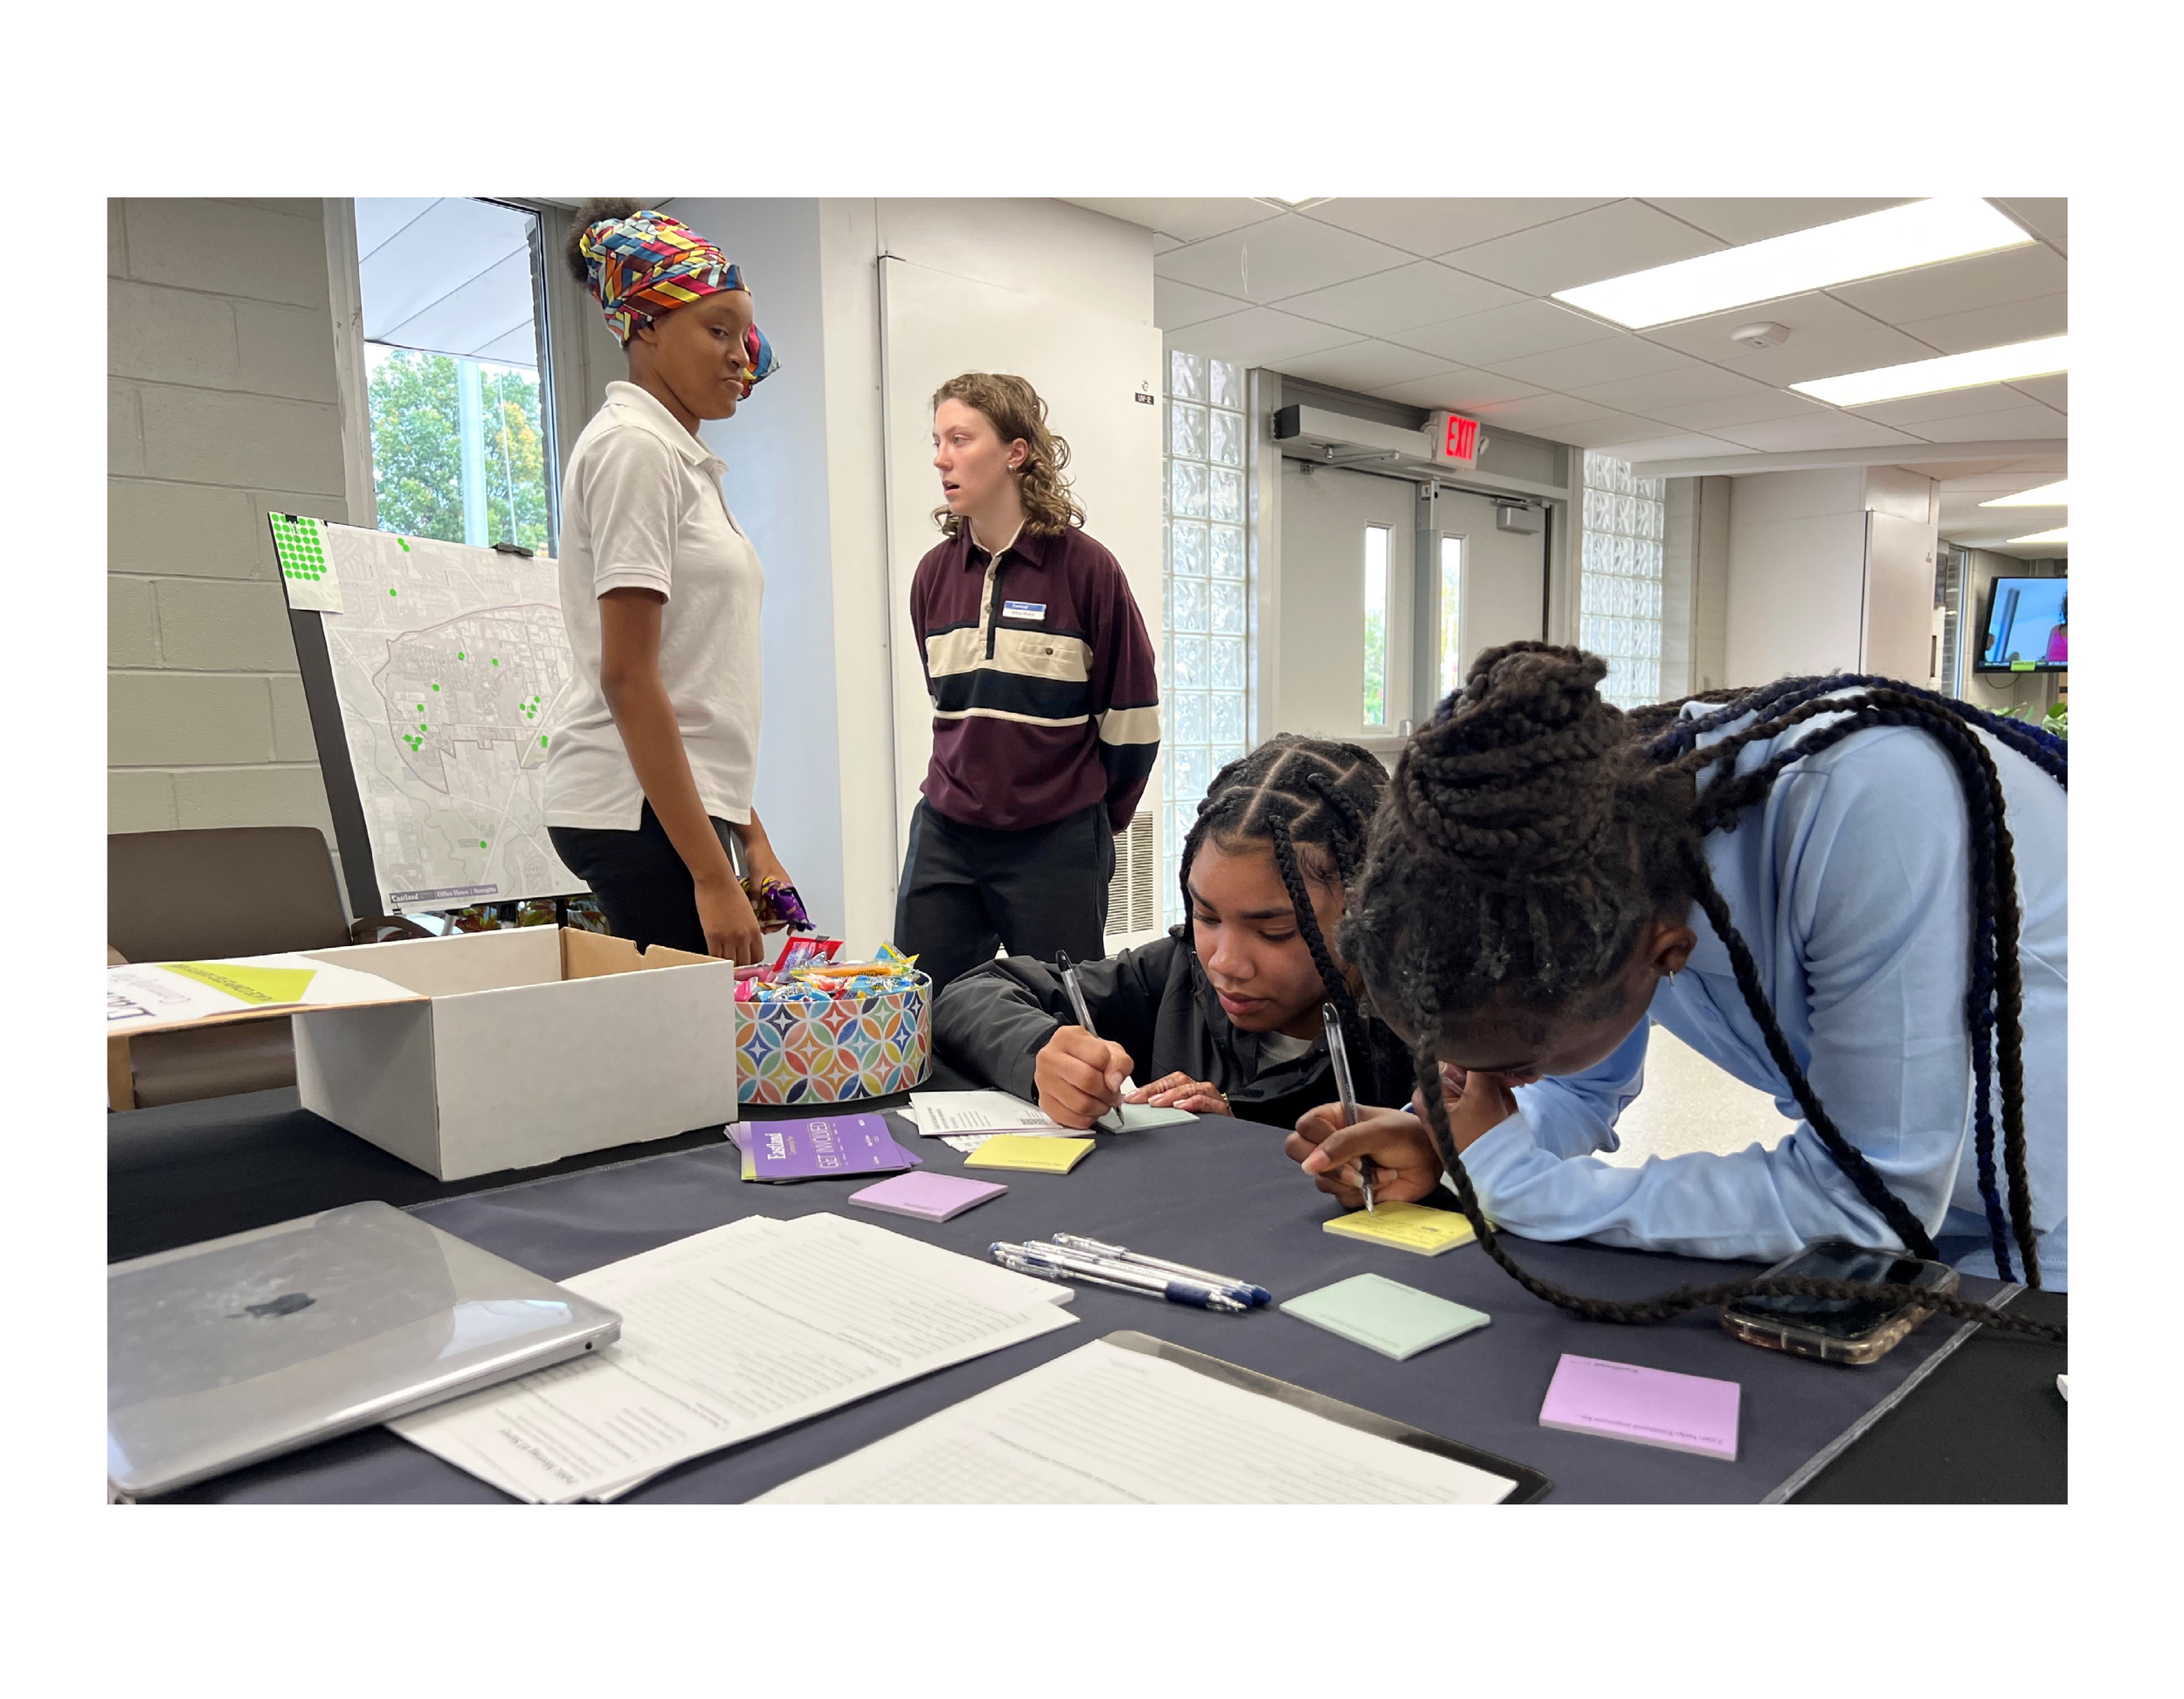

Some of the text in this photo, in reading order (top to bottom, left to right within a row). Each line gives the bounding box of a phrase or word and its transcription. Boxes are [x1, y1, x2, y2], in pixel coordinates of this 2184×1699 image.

[1446, 415, 1477, 462] EXIT
[473, 886, 497, 895] Strengths
[764, 1132, 786, 1161] Eastland
[809, 1122, 840, 1169] GET INVOLVED
